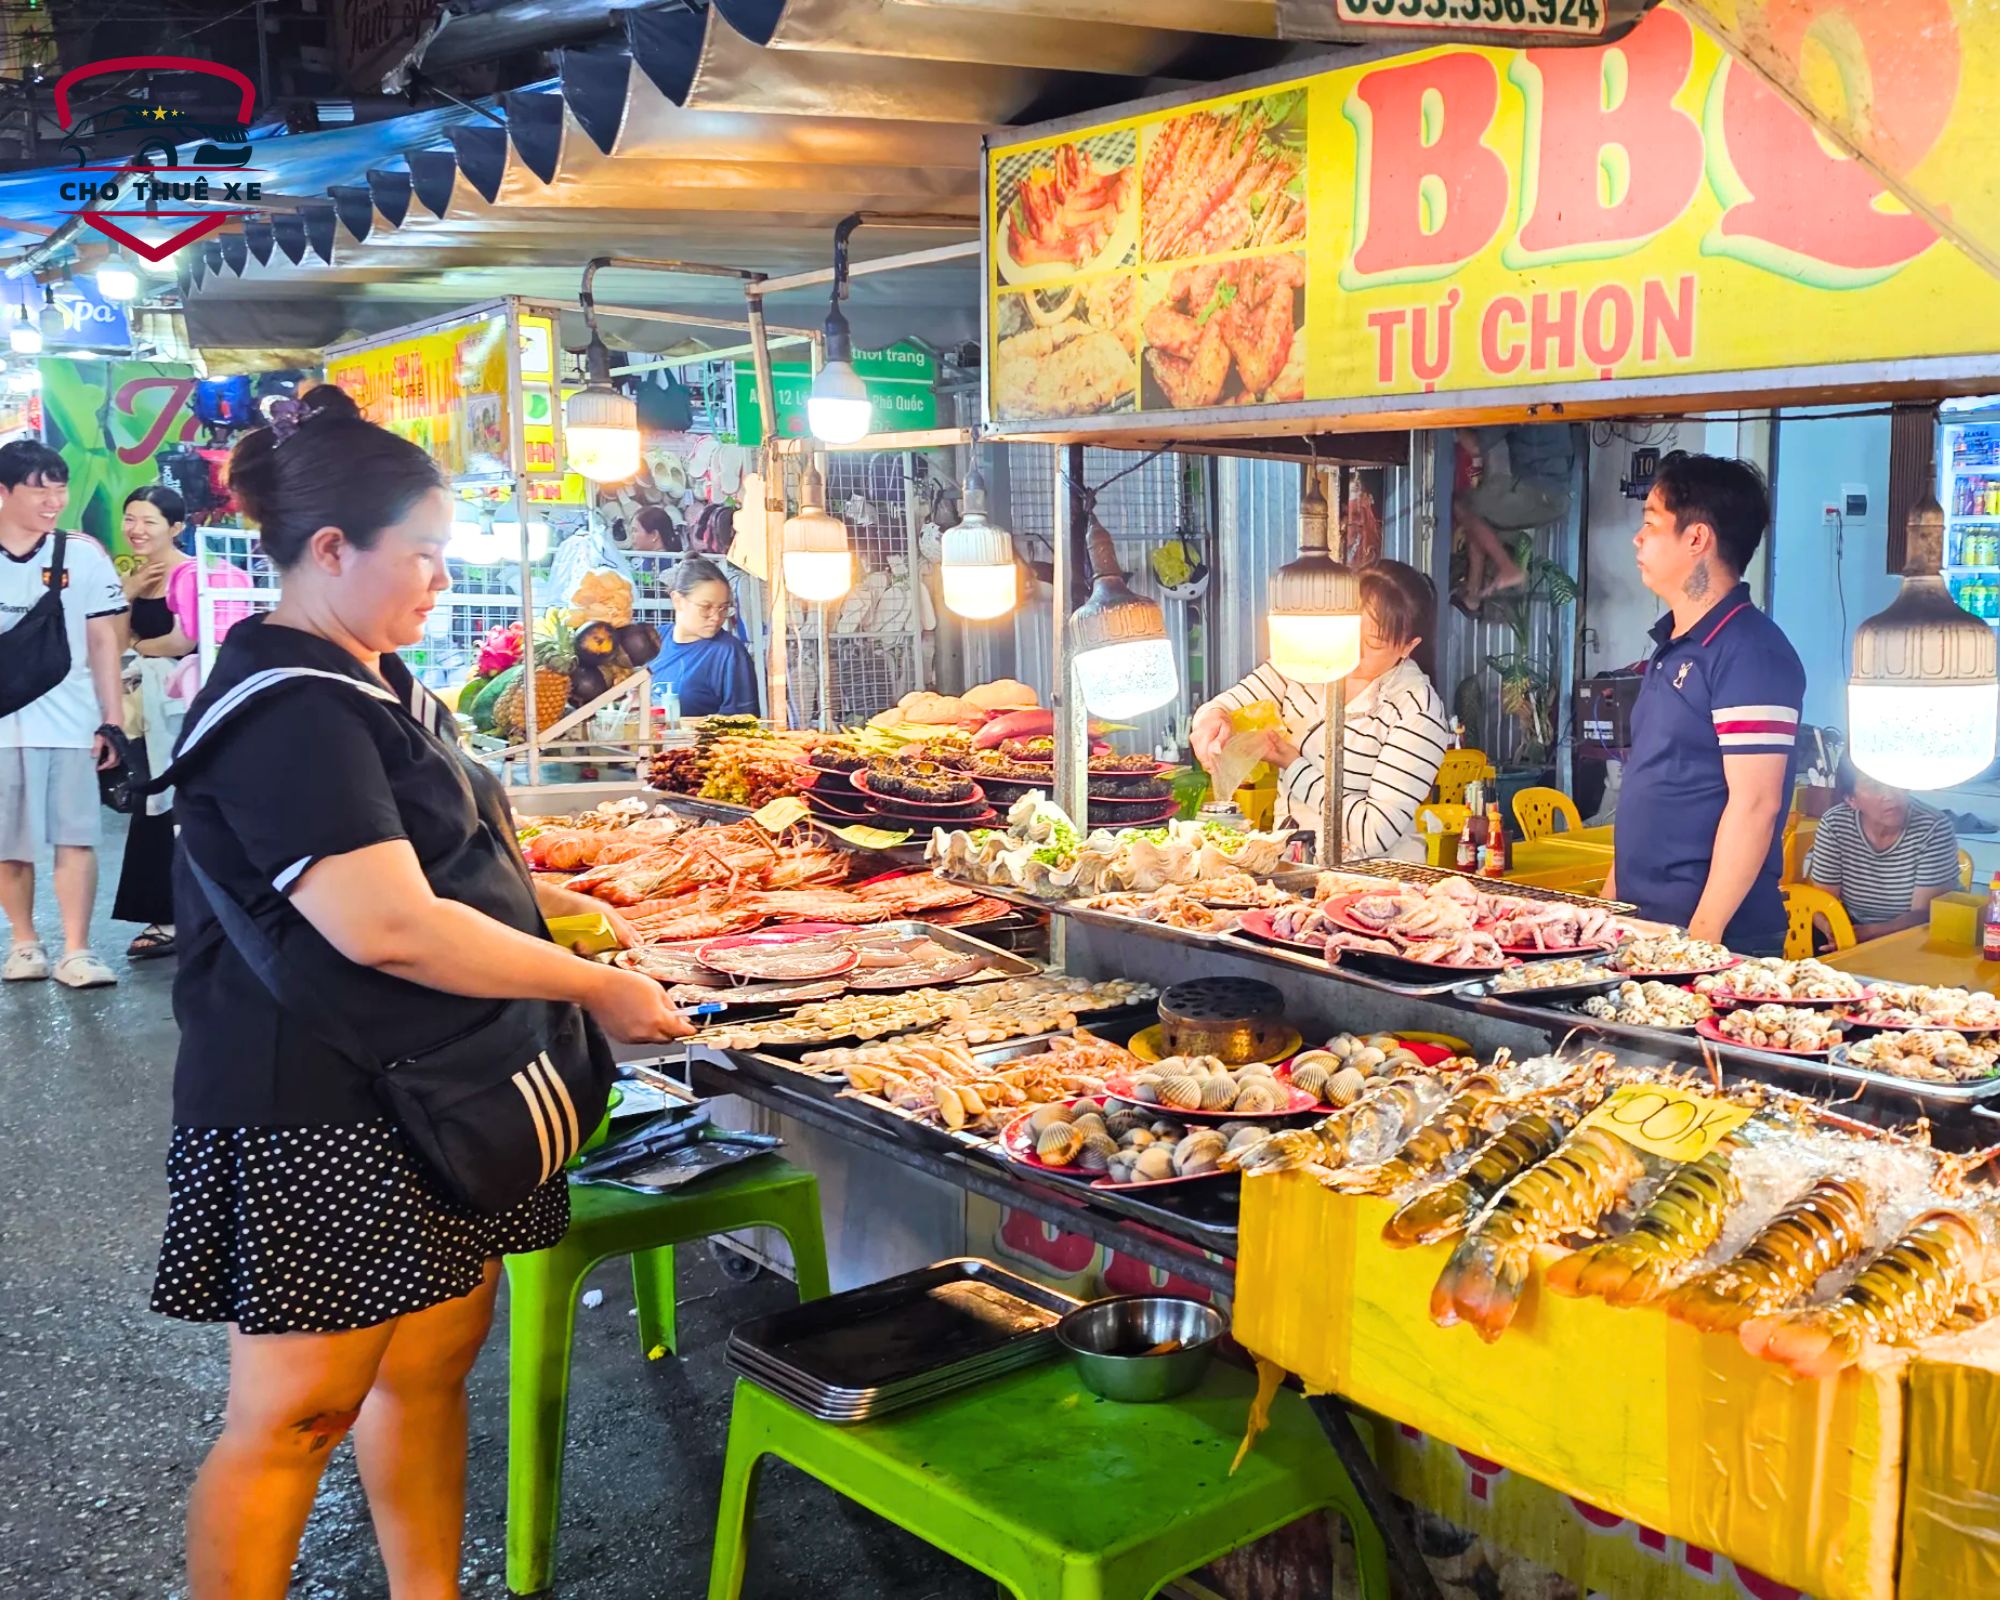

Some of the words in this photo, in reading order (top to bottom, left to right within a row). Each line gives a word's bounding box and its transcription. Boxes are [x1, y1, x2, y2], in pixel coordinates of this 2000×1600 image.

[1338, 0, 1962, 291] BBQ
[1367, 287, 1461, 394] TỰ
[1481, 275, 1695, 381] CHỌN
[887, 348, 925, 366] trang
[778, 389, 792, 405] 12
[896, 392, 925, 411] Quốc
[1640, 456, 1653, 476] 10
